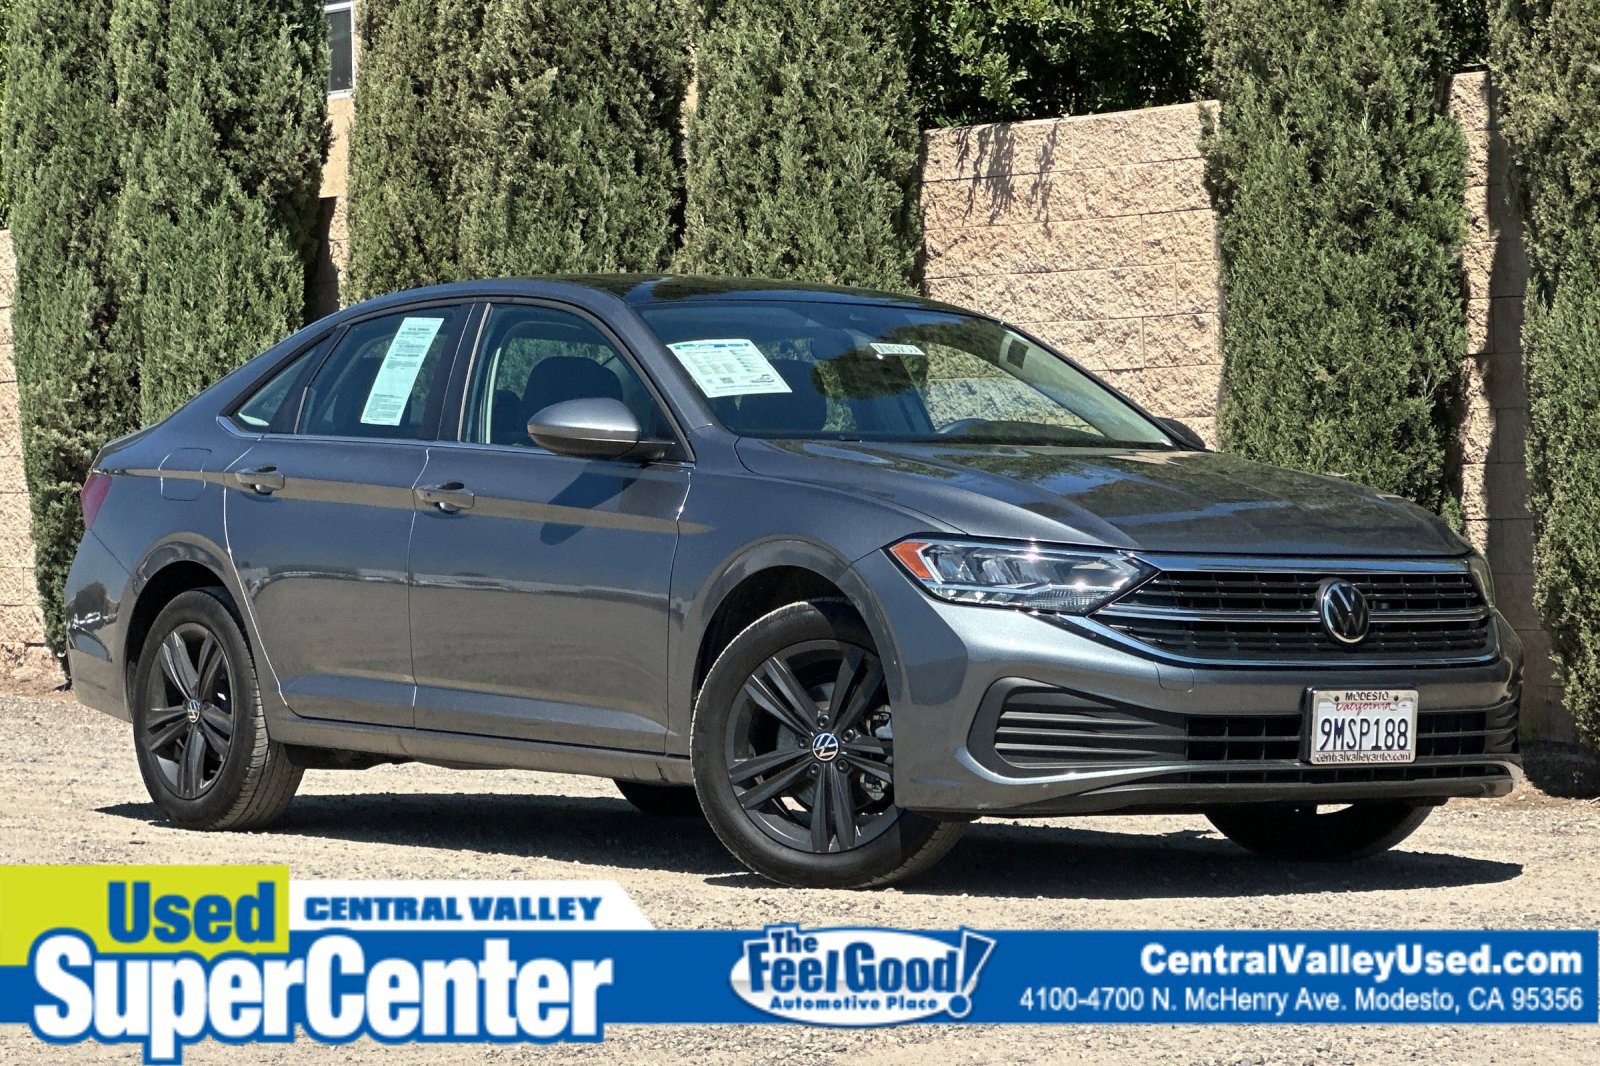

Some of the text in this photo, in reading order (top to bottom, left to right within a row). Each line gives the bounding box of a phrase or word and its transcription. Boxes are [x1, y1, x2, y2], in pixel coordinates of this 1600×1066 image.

[1345, 692, 1389, 701] MODESTO
[1320, 718, 1408, 750] 9MSP188
[1316, 751, 1411, 763] centralvalleyauto.com
